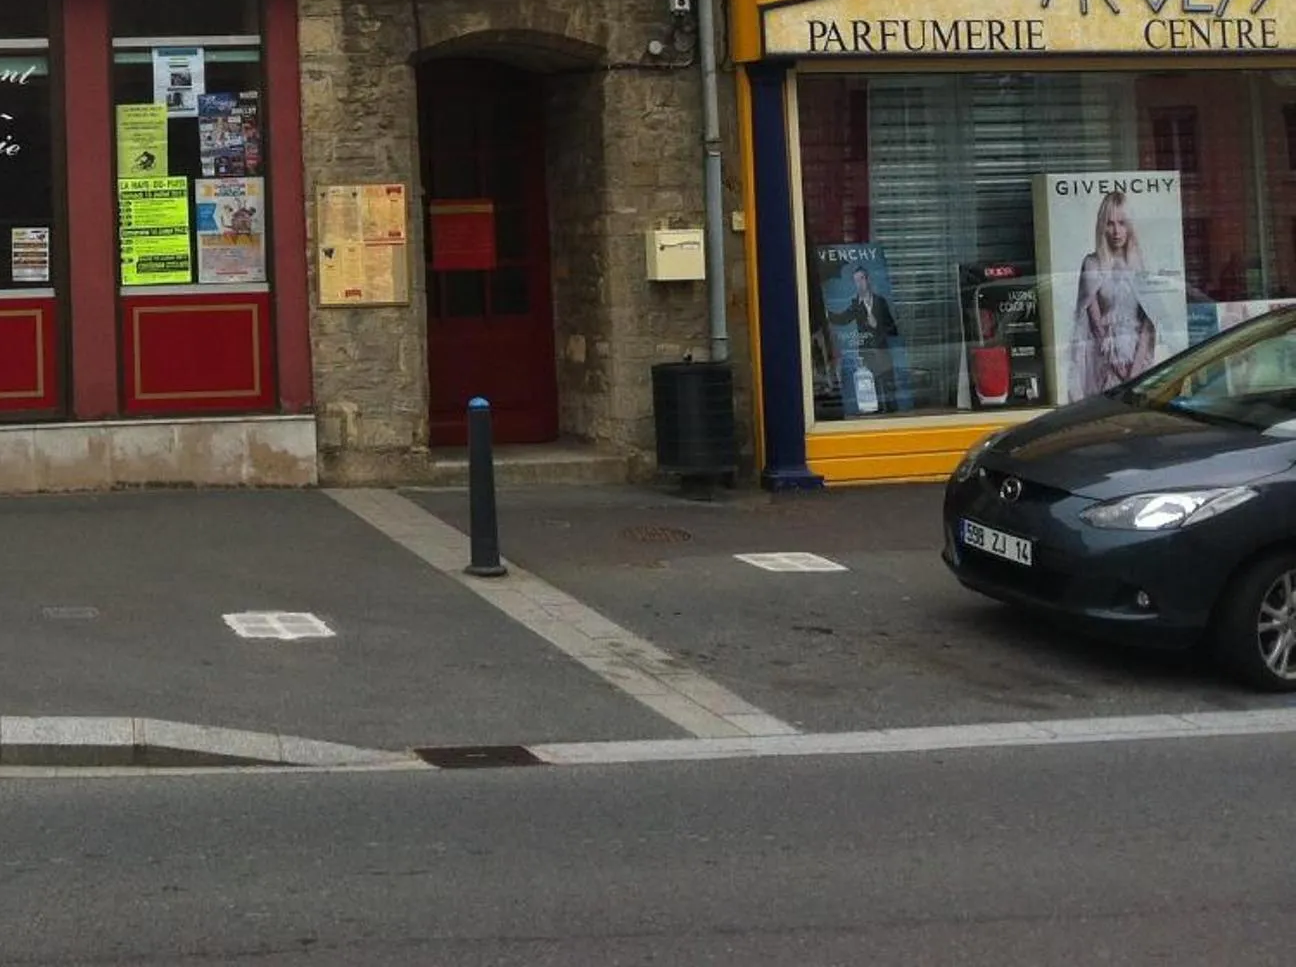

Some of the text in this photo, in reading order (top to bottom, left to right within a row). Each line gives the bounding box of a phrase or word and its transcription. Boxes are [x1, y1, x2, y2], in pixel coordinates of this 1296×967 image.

[807, 17, 1280, 53] PARFUMERIE CENTRE
[1055, 178, 1175, 196] GIVENCHY
[818, 248, 877, 262] VENCHY
[1015, 540, 1030, 563] 14
